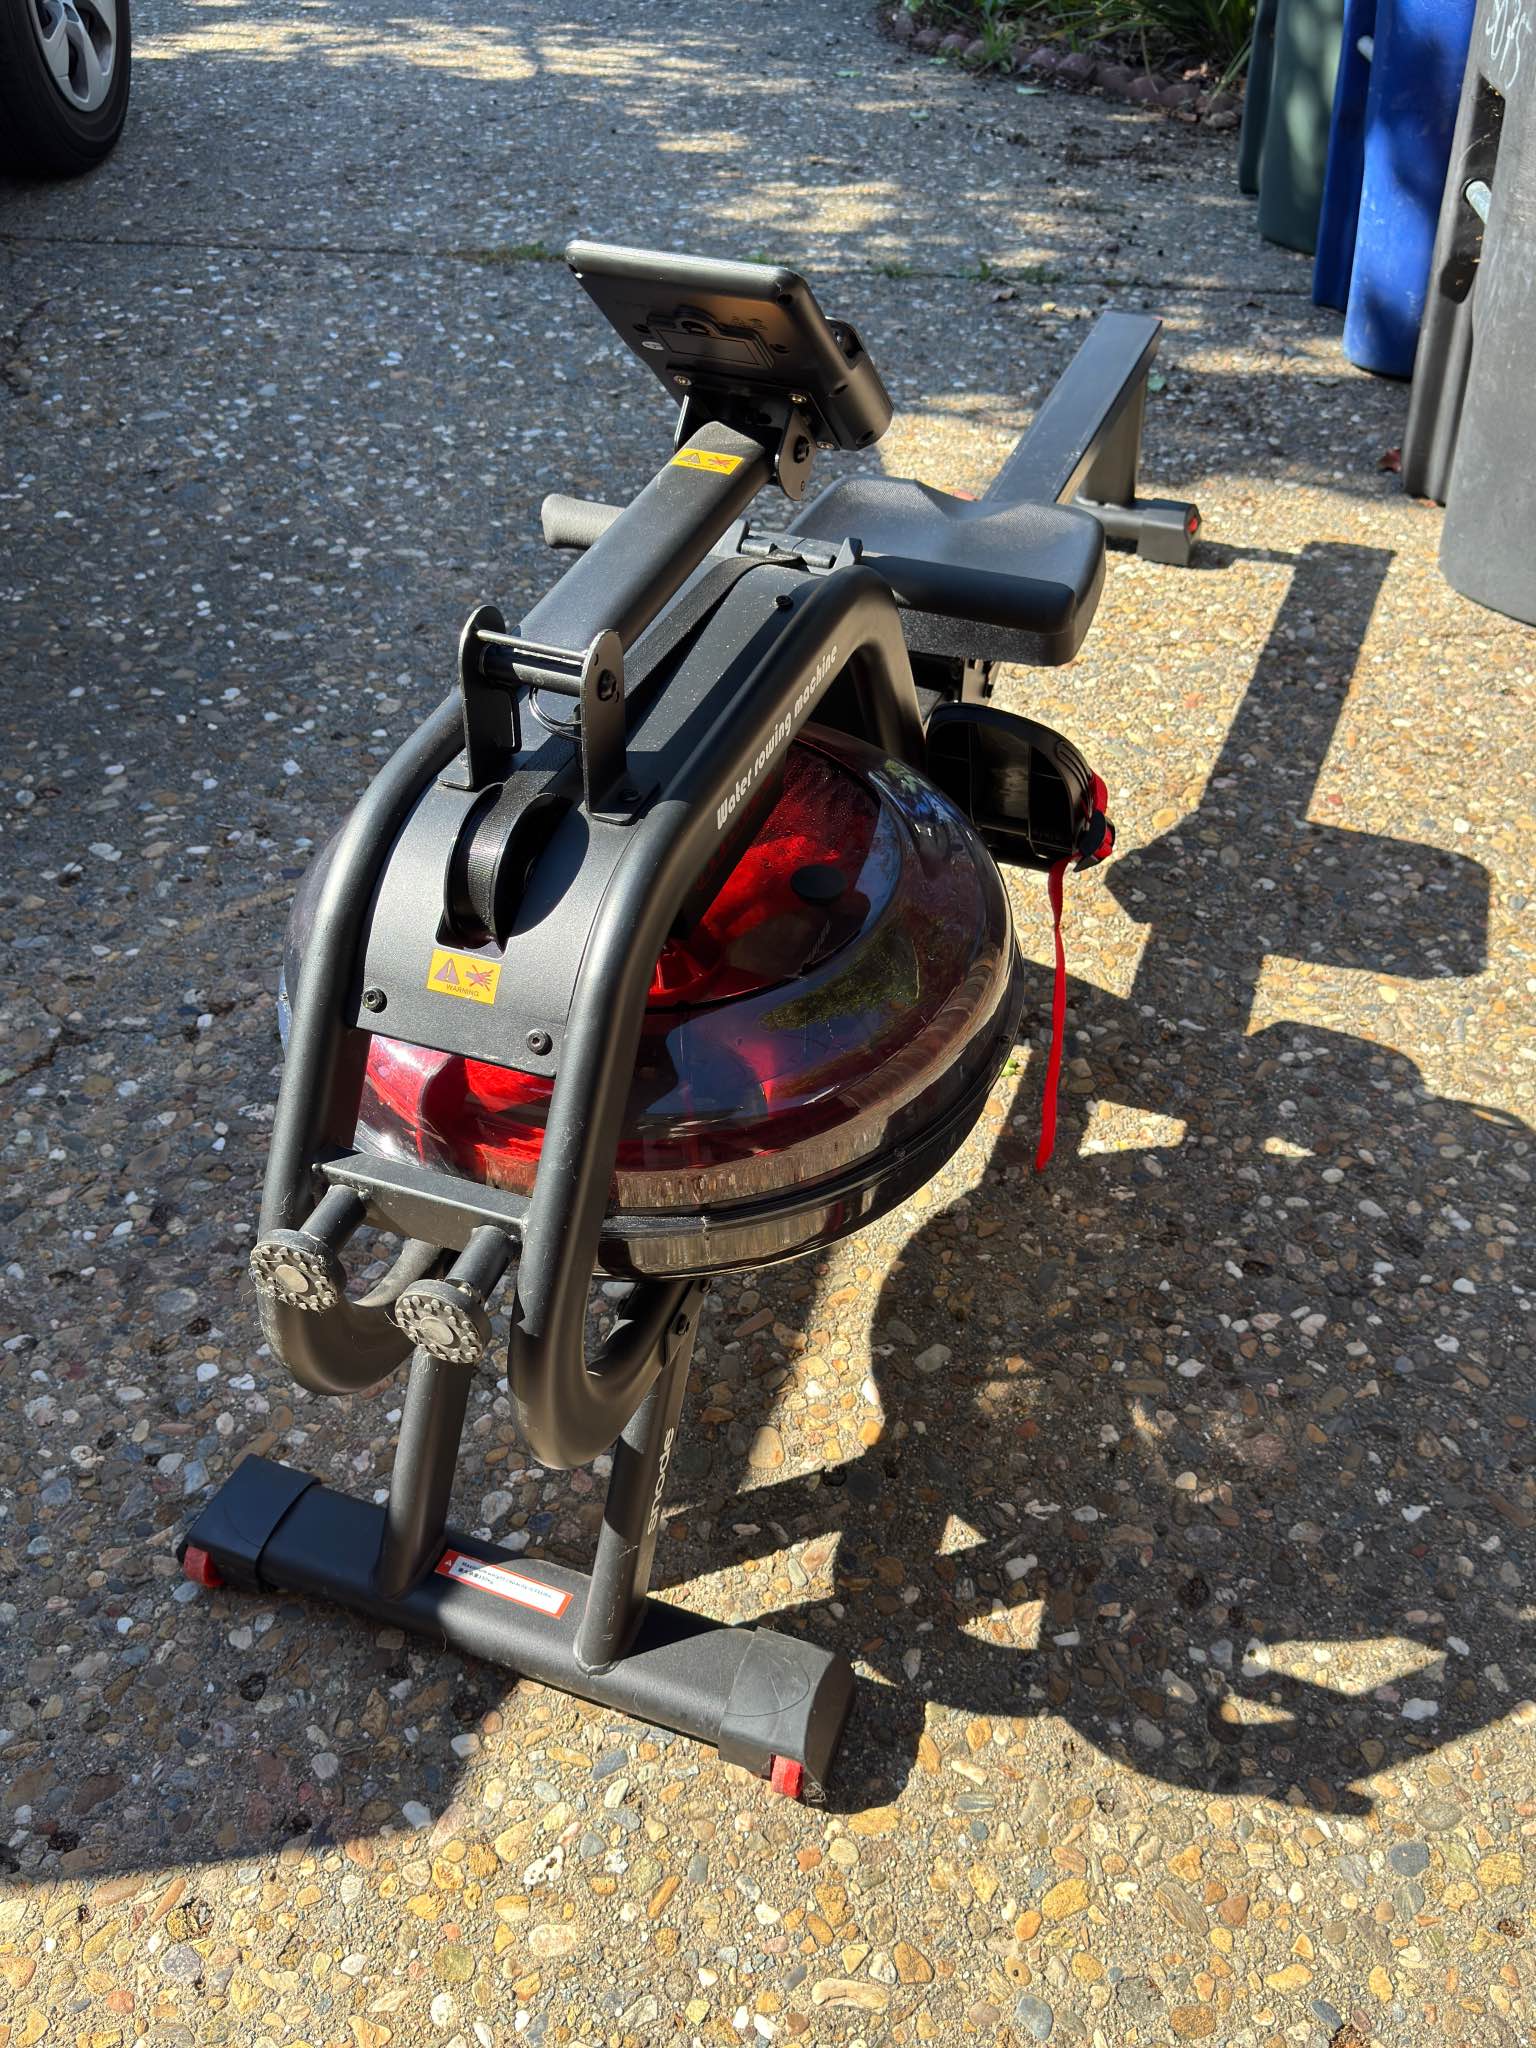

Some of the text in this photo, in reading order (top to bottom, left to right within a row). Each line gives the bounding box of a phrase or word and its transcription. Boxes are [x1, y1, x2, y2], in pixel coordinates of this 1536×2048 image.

[717, 768, 752, 830] Water
[754, 712, 791, 776] rowing
[794, 645, 838, 718] machine
[446, 984, 480, 997] WARNING
[648, 1427, 675, 1536] snode
